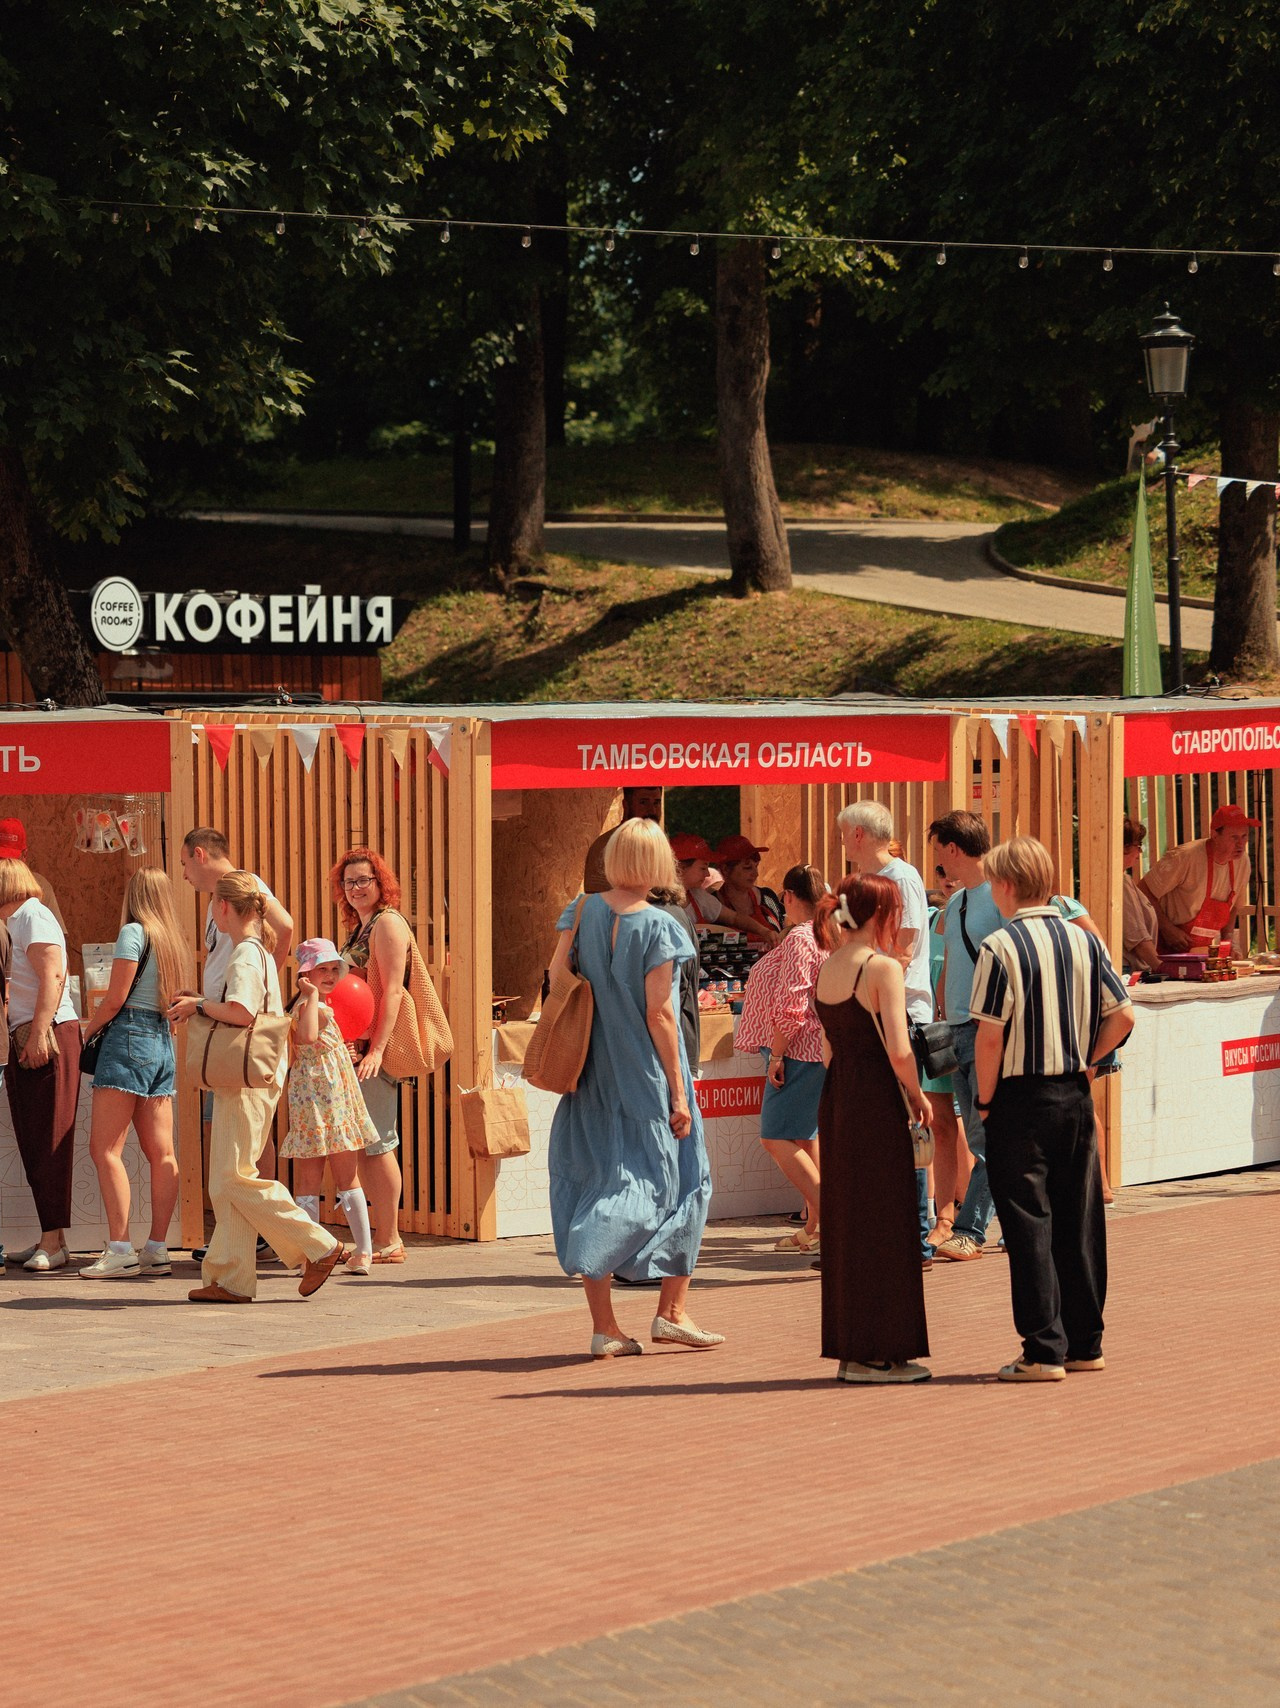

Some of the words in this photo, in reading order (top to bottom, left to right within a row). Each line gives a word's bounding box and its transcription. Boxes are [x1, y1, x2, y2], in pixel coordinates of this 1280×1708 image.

[100, 601, 134, 612] COFFEE
[155, 584, 393, 644] КОФЕЙНЯ
[101, 616, 133, 626] ROOMS
[577, 742, 750, 771] ТАМБОВСКАЯ
[757, 741, 872, 768] ОБЛАСТЬ
[1224, 1046, 1249, 1068] ВКУСЫ
[1250, 1042, 1280, 1063] РОССИИ
[713, 1086, 761, 1108] РОССИИ
